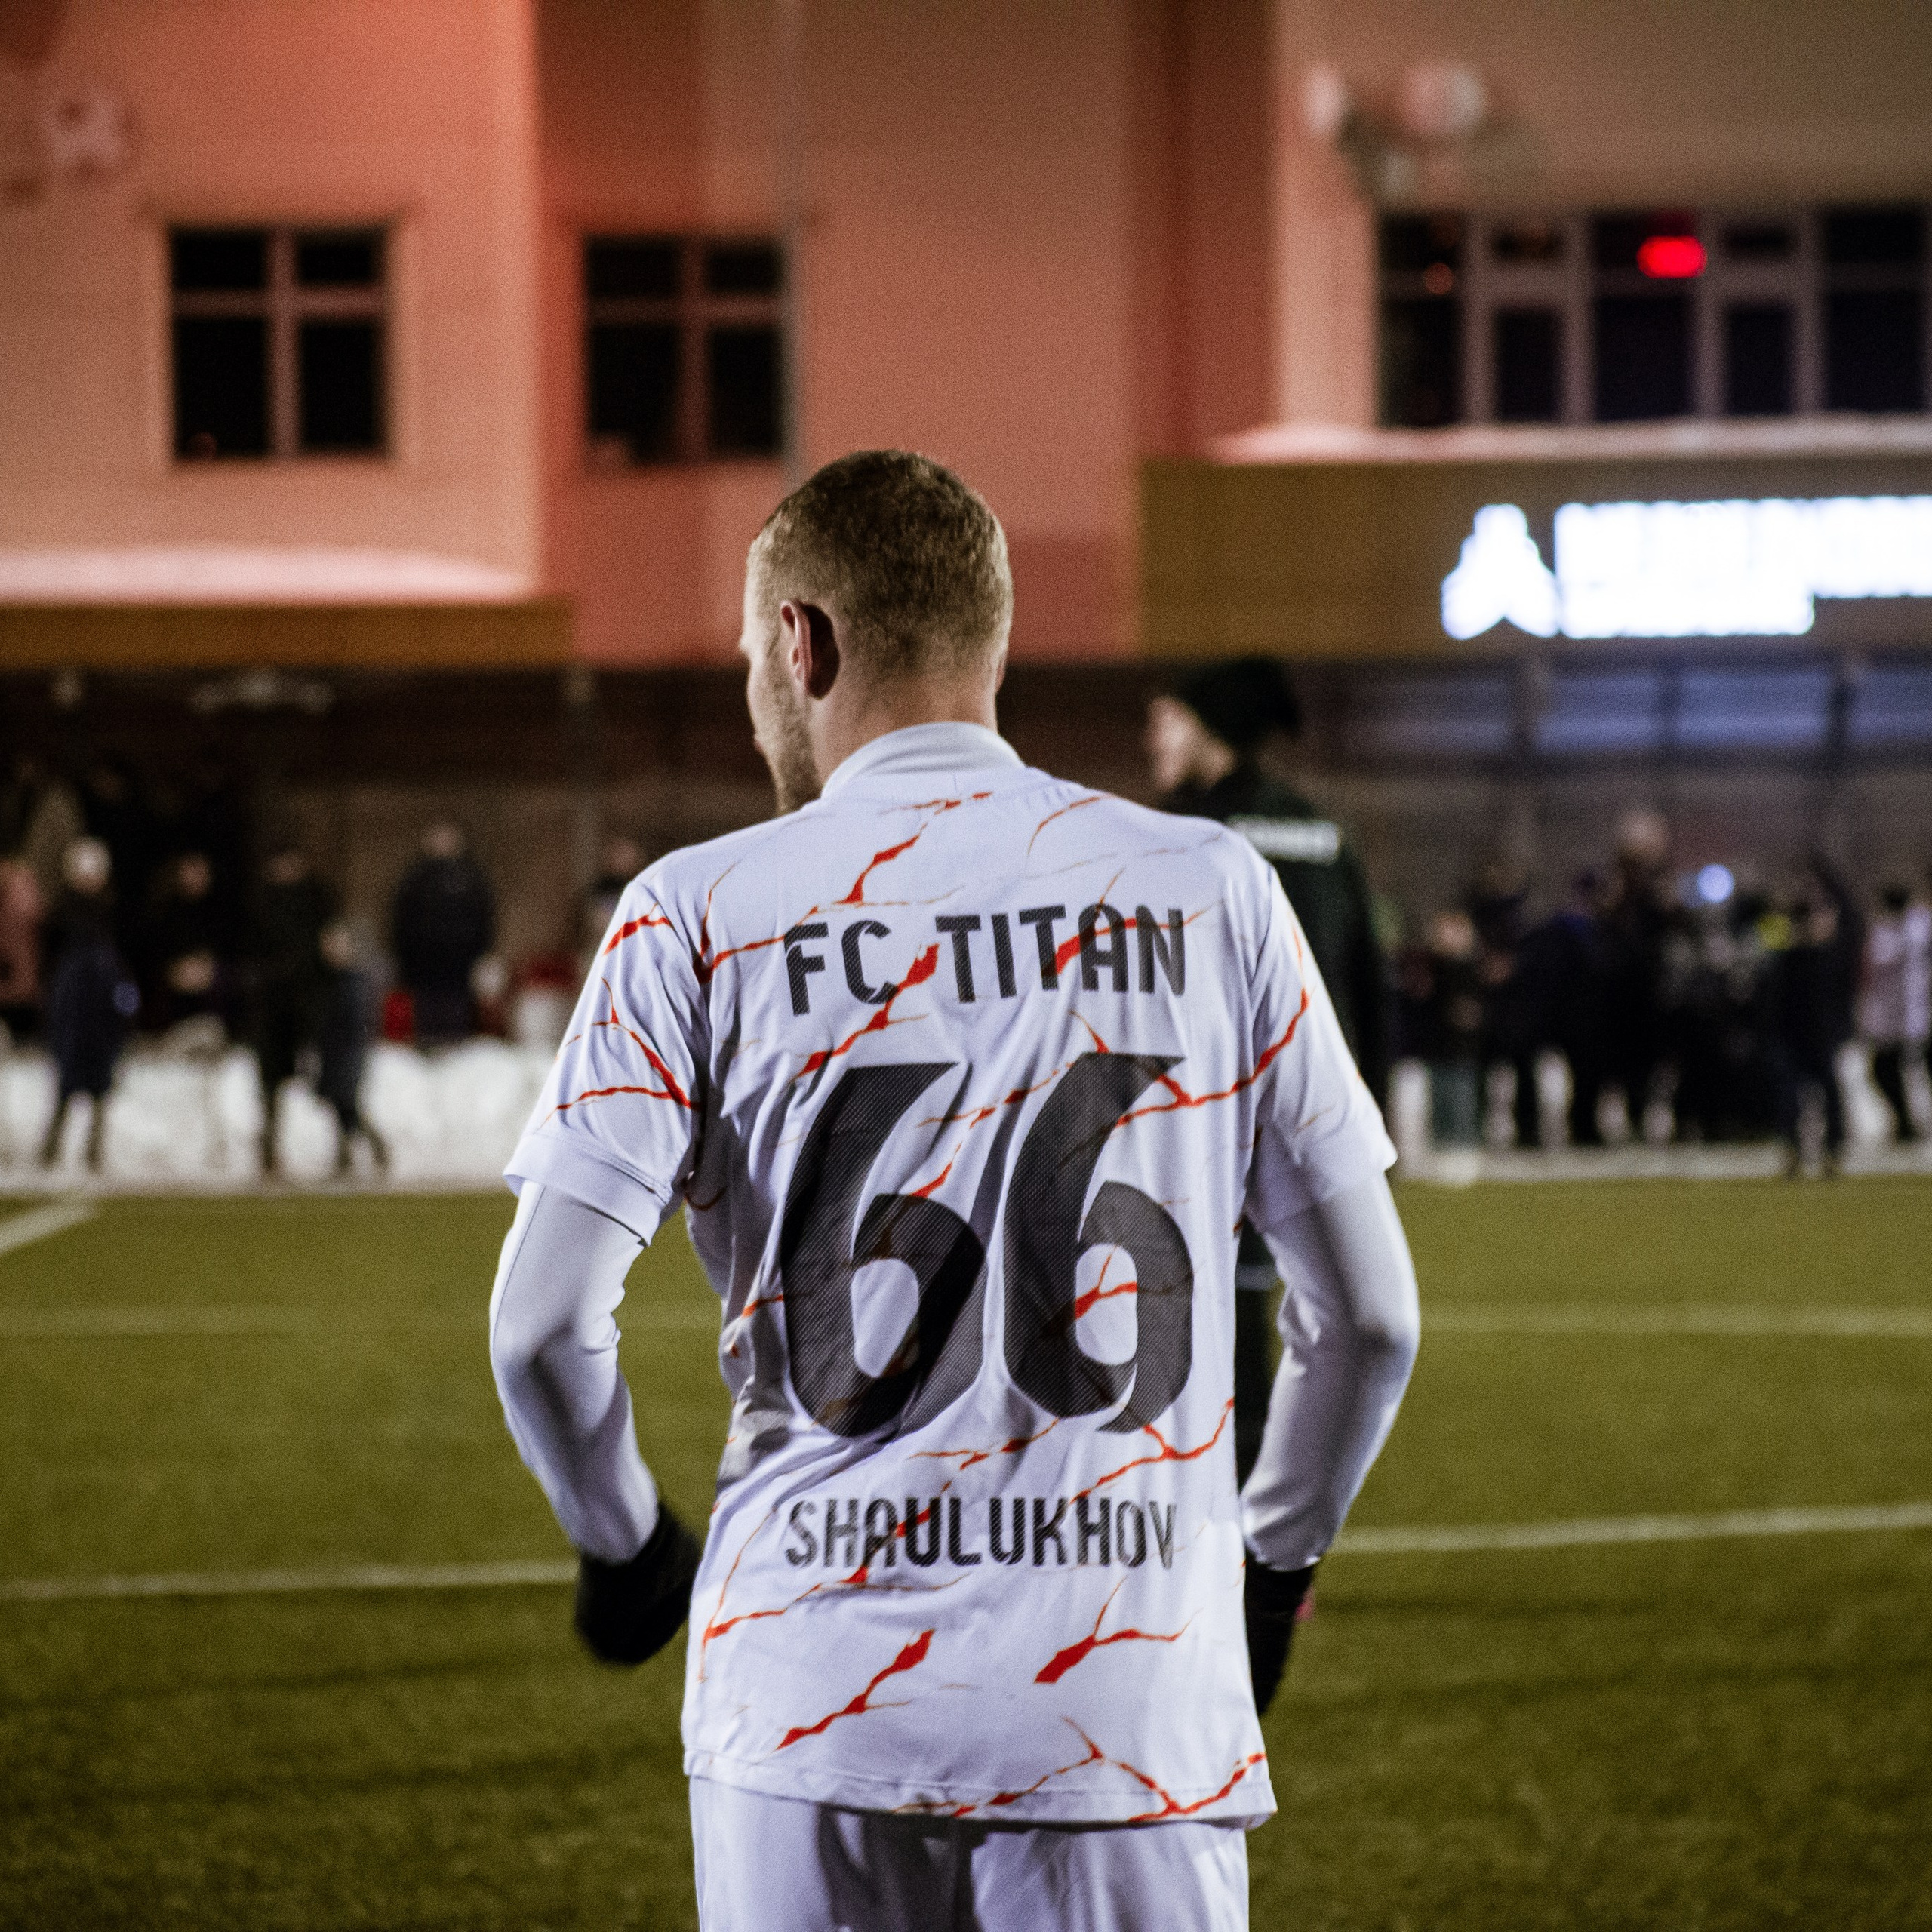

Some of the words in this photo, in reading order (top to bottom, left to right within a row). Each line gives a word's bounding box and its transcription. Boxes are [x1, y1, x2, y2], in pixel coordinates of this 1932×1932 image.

[783, 919, 900, 1016] FC
[935, 903, 1185, 1004] TITAN
[780, 1052, 1194, 1438] 66
[785, 1497, 1177, 1570] SHAULUKHOV
